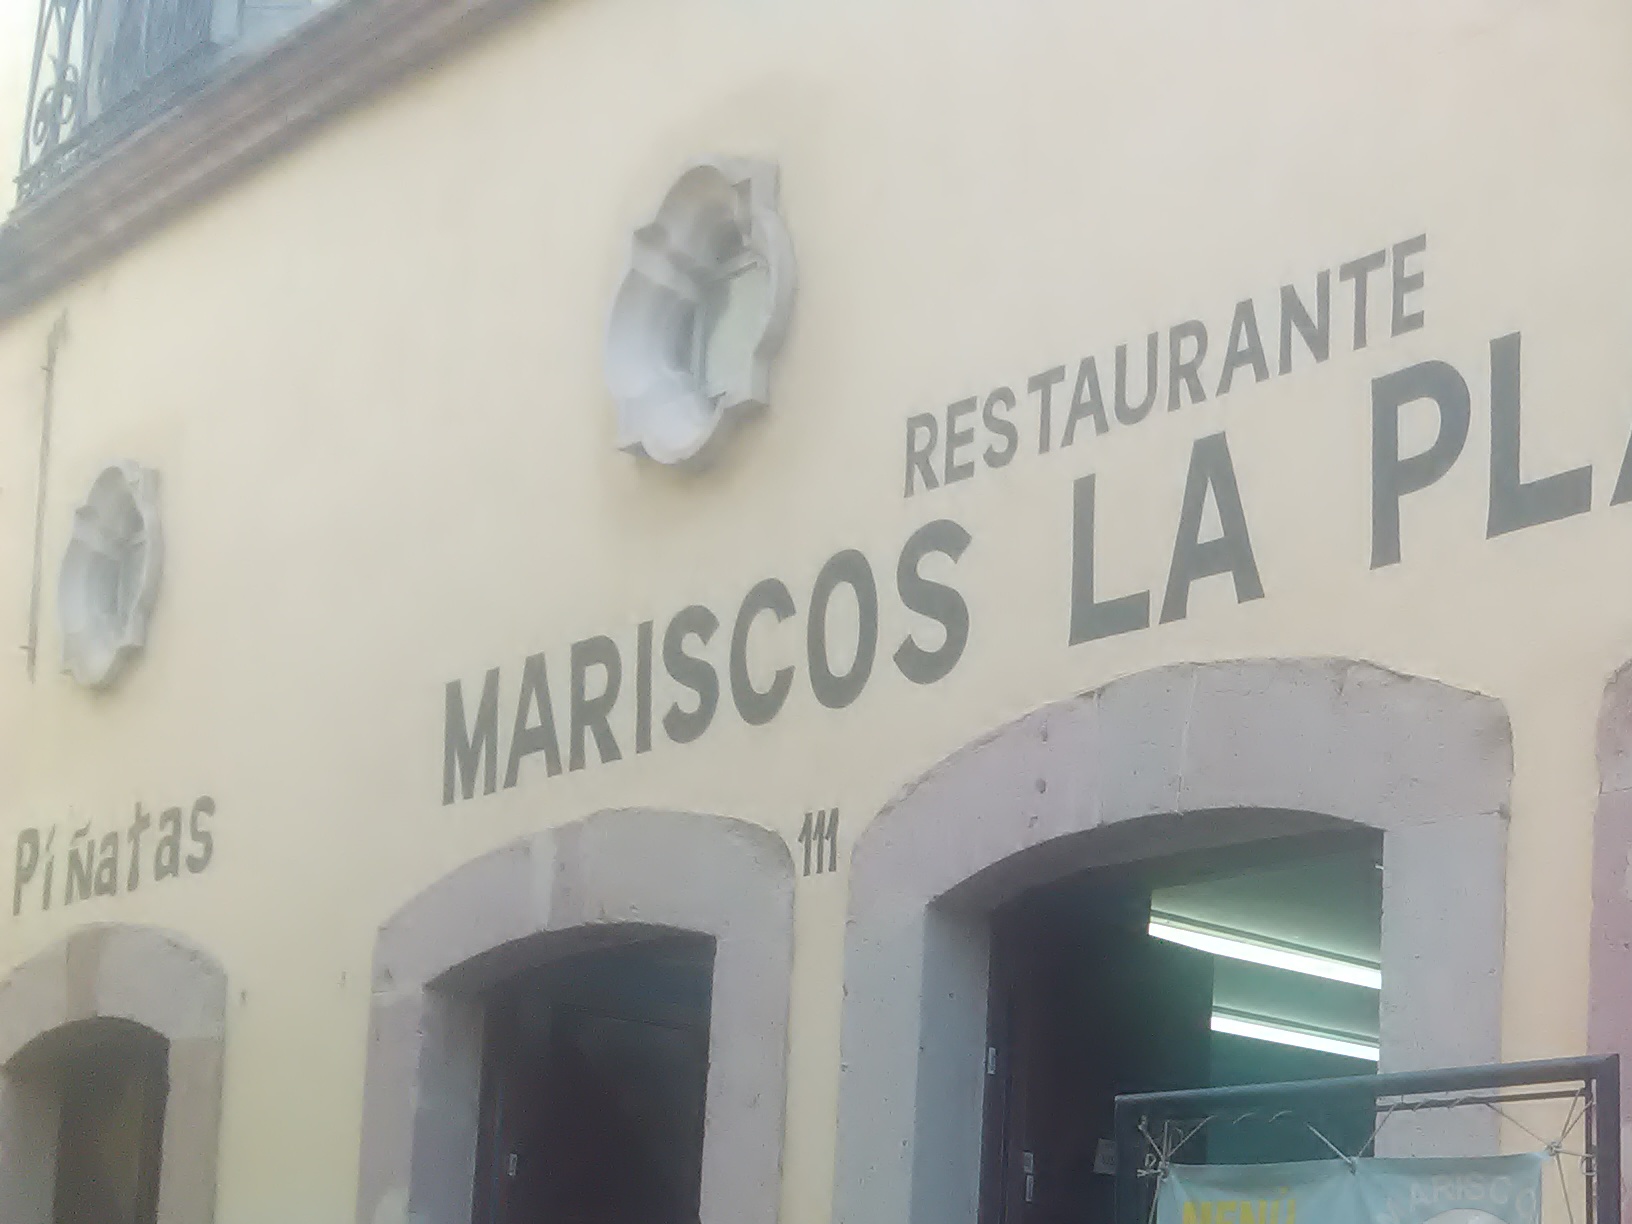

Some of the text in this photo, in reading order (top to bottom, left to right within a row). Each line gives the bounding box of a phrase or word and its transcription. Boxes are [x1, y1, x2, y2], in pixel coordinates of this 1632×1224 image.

[903, 234, 1427, 499] RESTAURANTE
[442, 519, 972, 806] MARISCOS
[1068, 430, 1266, 646] LA
[798, 807, 839, 877] 111
